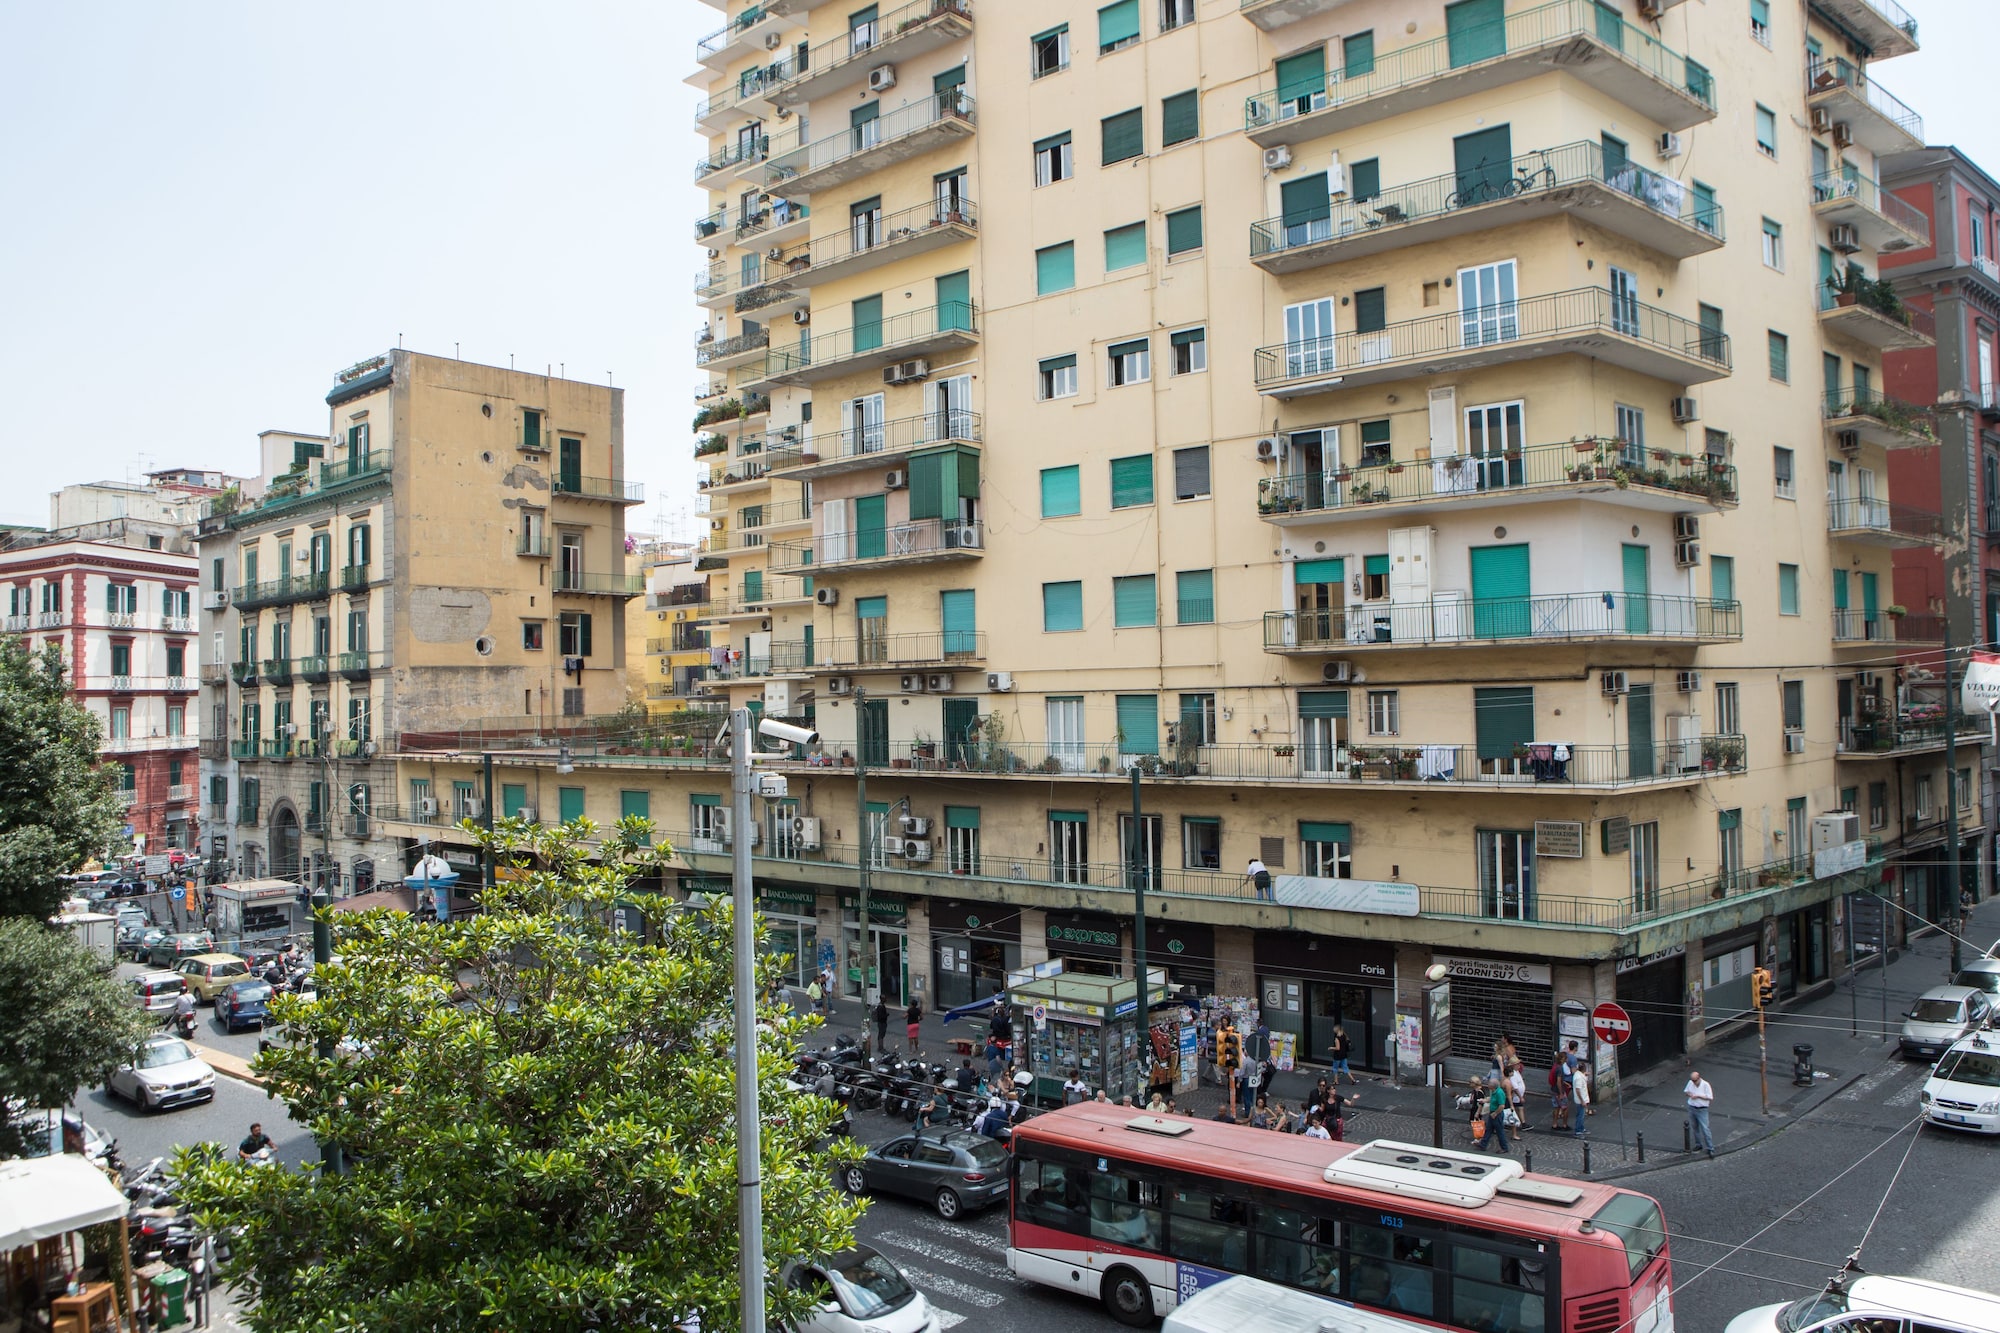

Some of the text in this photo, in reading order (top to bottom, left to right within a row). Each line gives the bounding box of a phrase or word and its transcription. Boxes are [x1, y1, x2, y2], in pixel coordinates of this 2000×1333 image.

[768, 889, 787, 899] BANCO
[791, 893, 813, 902] NAPOLI
[880, 902, 904, 913] NAPOLI
[1063, 928, 1117, 945] express
[1361, 964, 1386, 975] Foria
[1474, 961, 1489, 969] fino
[1449, 965, 1455, 973] 7
[1456, 966, 1491, 977] GIORNI
[1492, 970, 1506, 979] SU
[1508, 972, 1514, 980] 7
[1380, 1214, 1403, 1229] V513
[1180, 1273, 1198, 1286] IED
